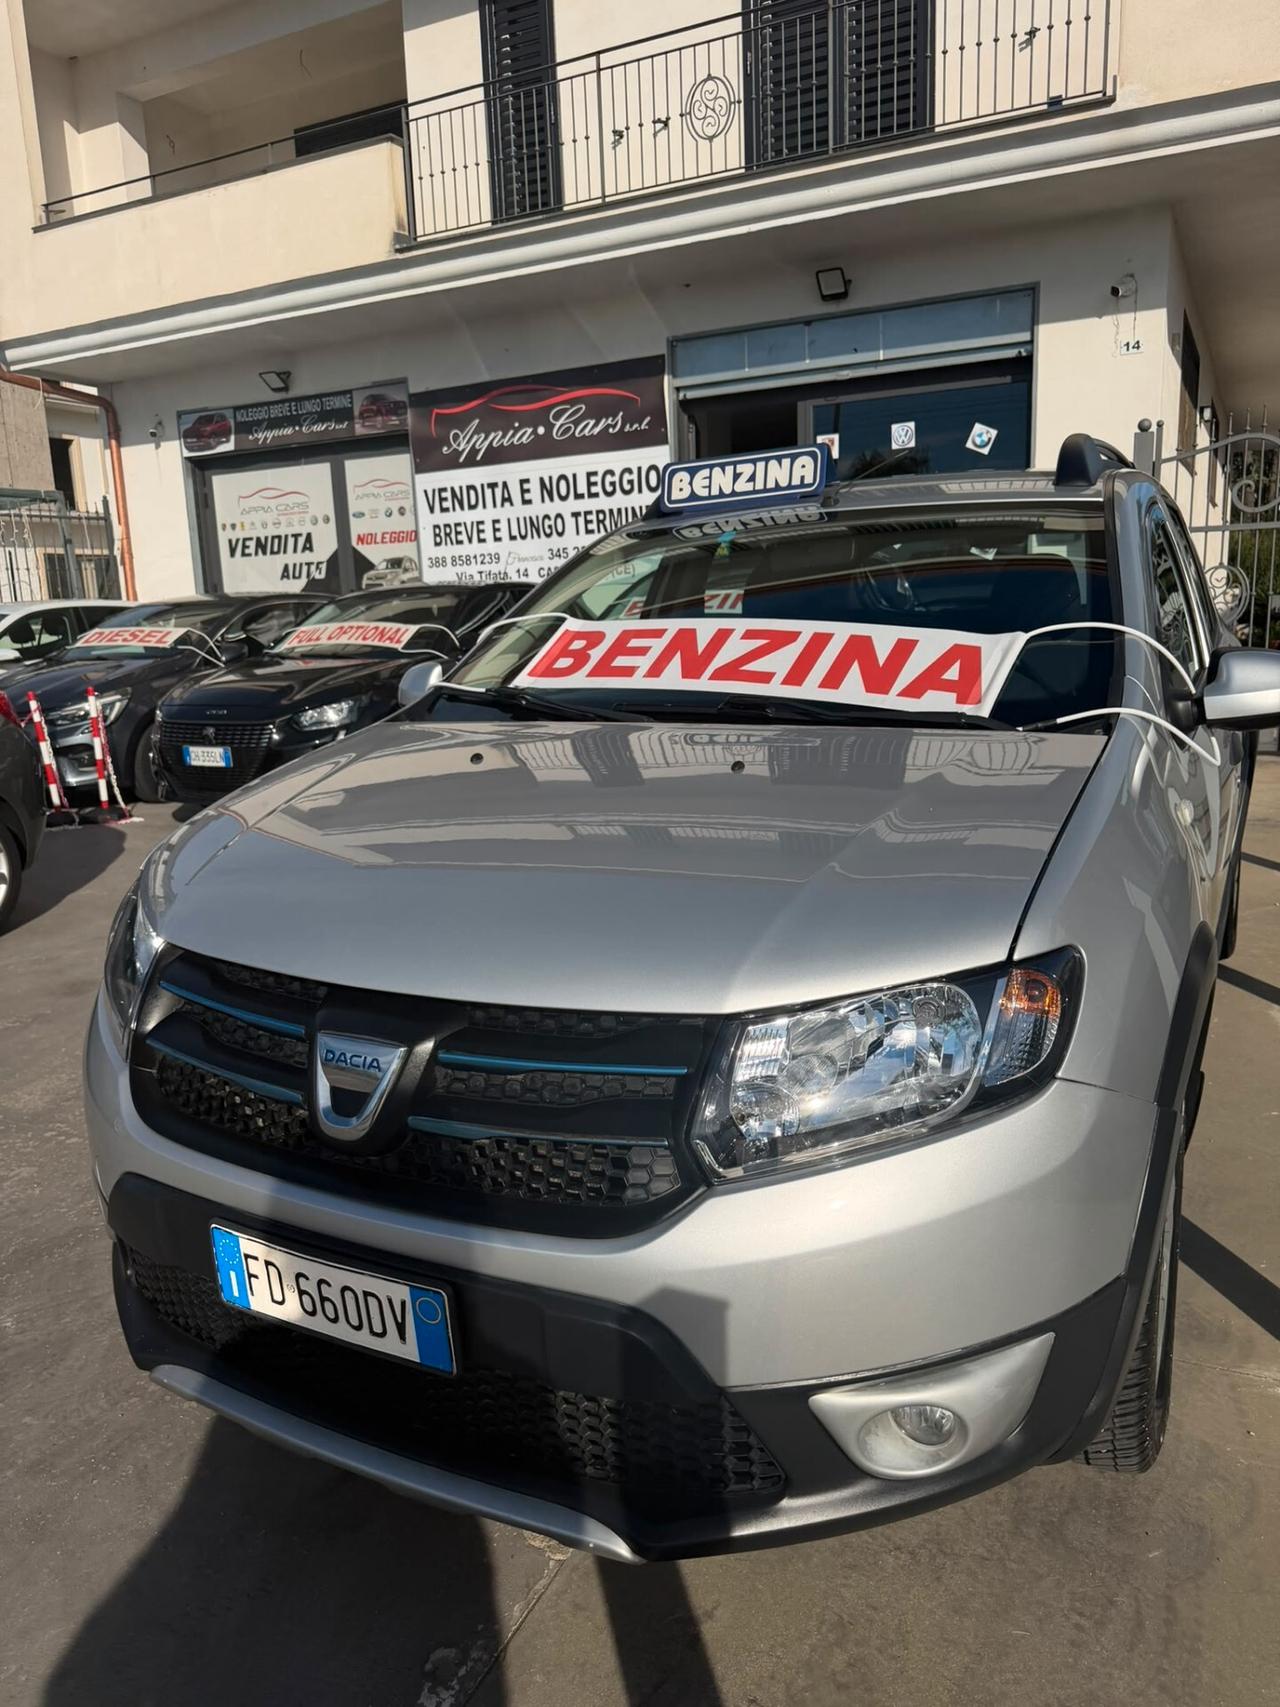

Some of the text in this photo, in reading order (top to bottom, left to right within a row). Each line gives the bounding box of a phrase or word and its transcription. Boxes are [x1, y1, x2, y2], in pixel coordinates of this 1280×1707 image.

[1123, 340, 1141, 351] 14
[236, 394, 352, 422] NOLEGGIO BREVE E LUNGO TERMINE
[442, 418, 535, 463] Appia
[550, 404, 624, 441] Cars
[671, 455, 816, 500] BENZINA
[424, 464, 661, 514] VENDITA E NOLEGGIO
[240, 505, 273, 516] APPIA
[276, 502, 309, 512] CARS
[433, 505, 650, 547] BREVE E LUNGO TERMIN
[228, 532, 314, 559] VENDITA
[356, 530, 417, 546] NOLEGGIO
[428, 556, 447, 569] 388
[451, 552, 500, 567] 8581239
[548, 547, 569, 560] 345
[280, 561, 327, 581] AUTO
[456, 572, 474, 581] Via
[516, 568, 529, 579] 14
[81, 630, 173, 645] DIESEL
[288, 625, 411, 645] FULL OPTIONAL
[526, 627, 983, 705] BENZINA
[323, 1049, 382, 1073] DACIA
